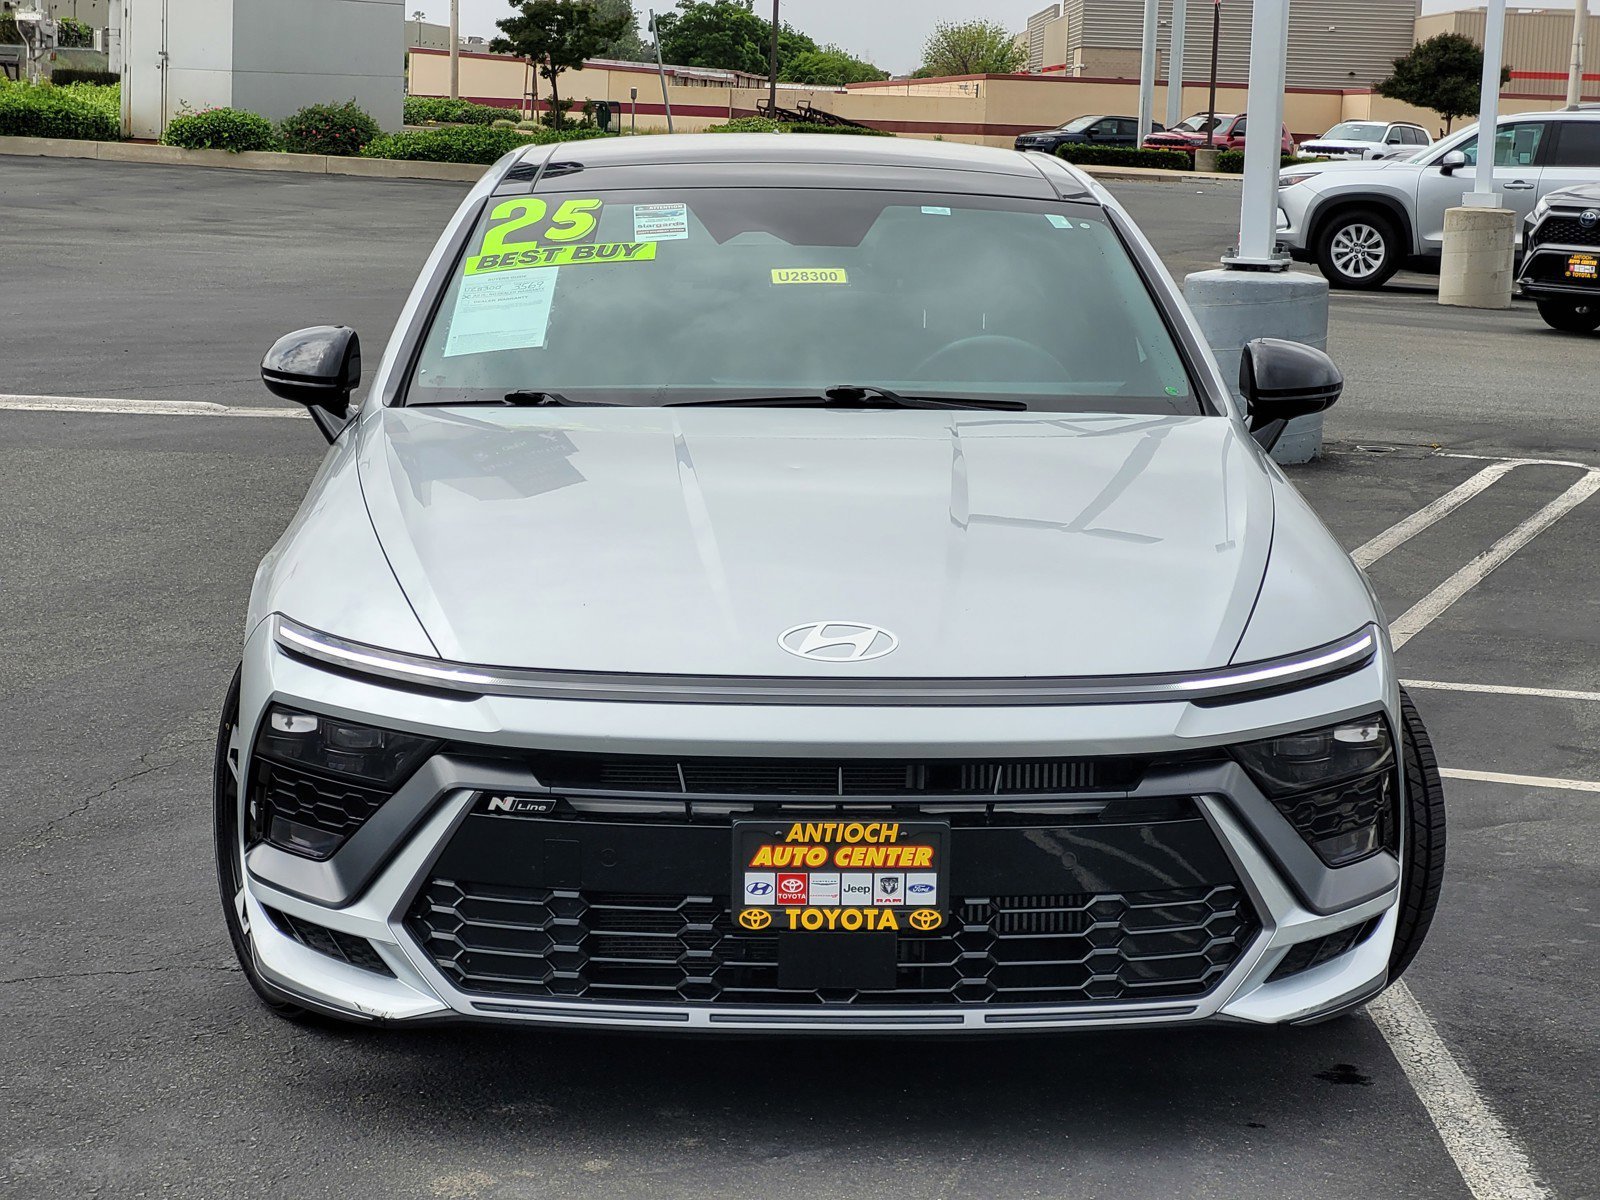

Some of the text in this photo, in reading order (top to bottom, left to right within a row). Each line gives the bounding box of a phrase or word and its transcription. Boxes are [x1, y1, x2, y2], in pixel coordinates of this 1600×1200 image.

[480, 198, 602, 256] 25
[476, 243, 647, 271] BEST BUY
[778, 271, 838, 282] U28300
[785, 823, 899, 843] ANTIOCH
[749, 845, 934, 868] AUTO CENTER
[843, 884, 871, 895] Jeep
[912, 885, 930, 893] Ford
[786, 909, 899, 931] TOYOTA
